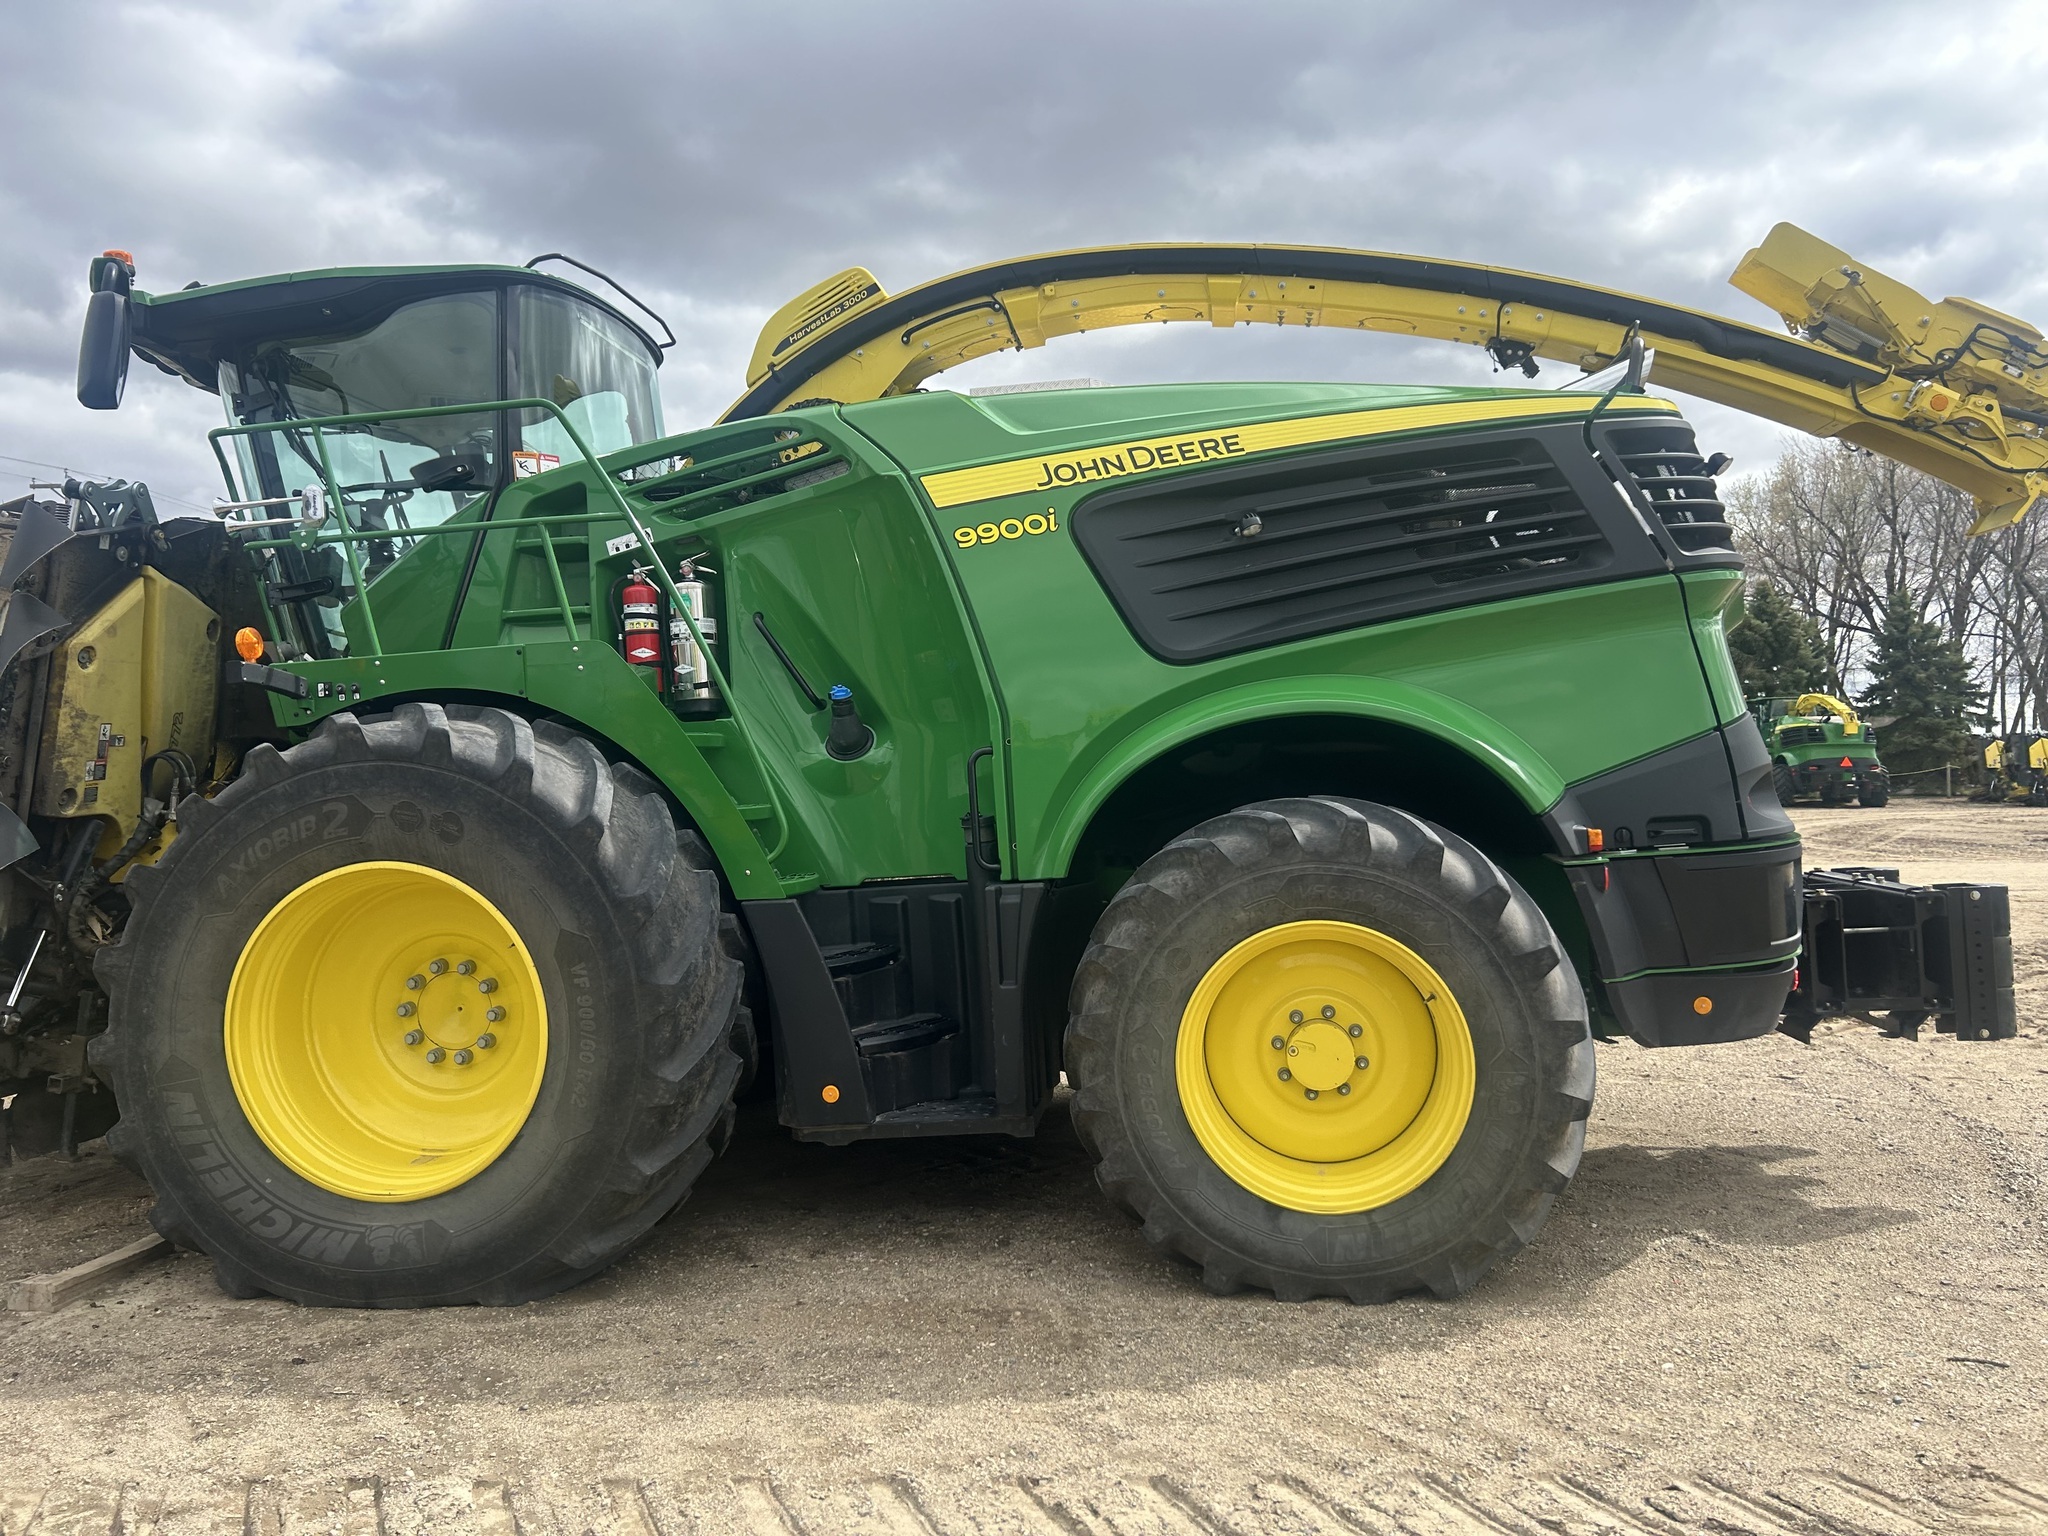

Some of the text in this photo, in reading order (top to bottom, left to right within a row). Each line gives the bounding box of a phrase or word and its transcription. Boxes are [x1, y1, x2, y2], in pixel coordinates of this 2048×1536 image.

[788, 290, 868, 343] HarvestLab 3000
[1037, 434, 1245, 487] JOHN DEERE
[953, 507, 1059, 549] 9900i
[162, 1090, 361, 1265] MICHELIN
